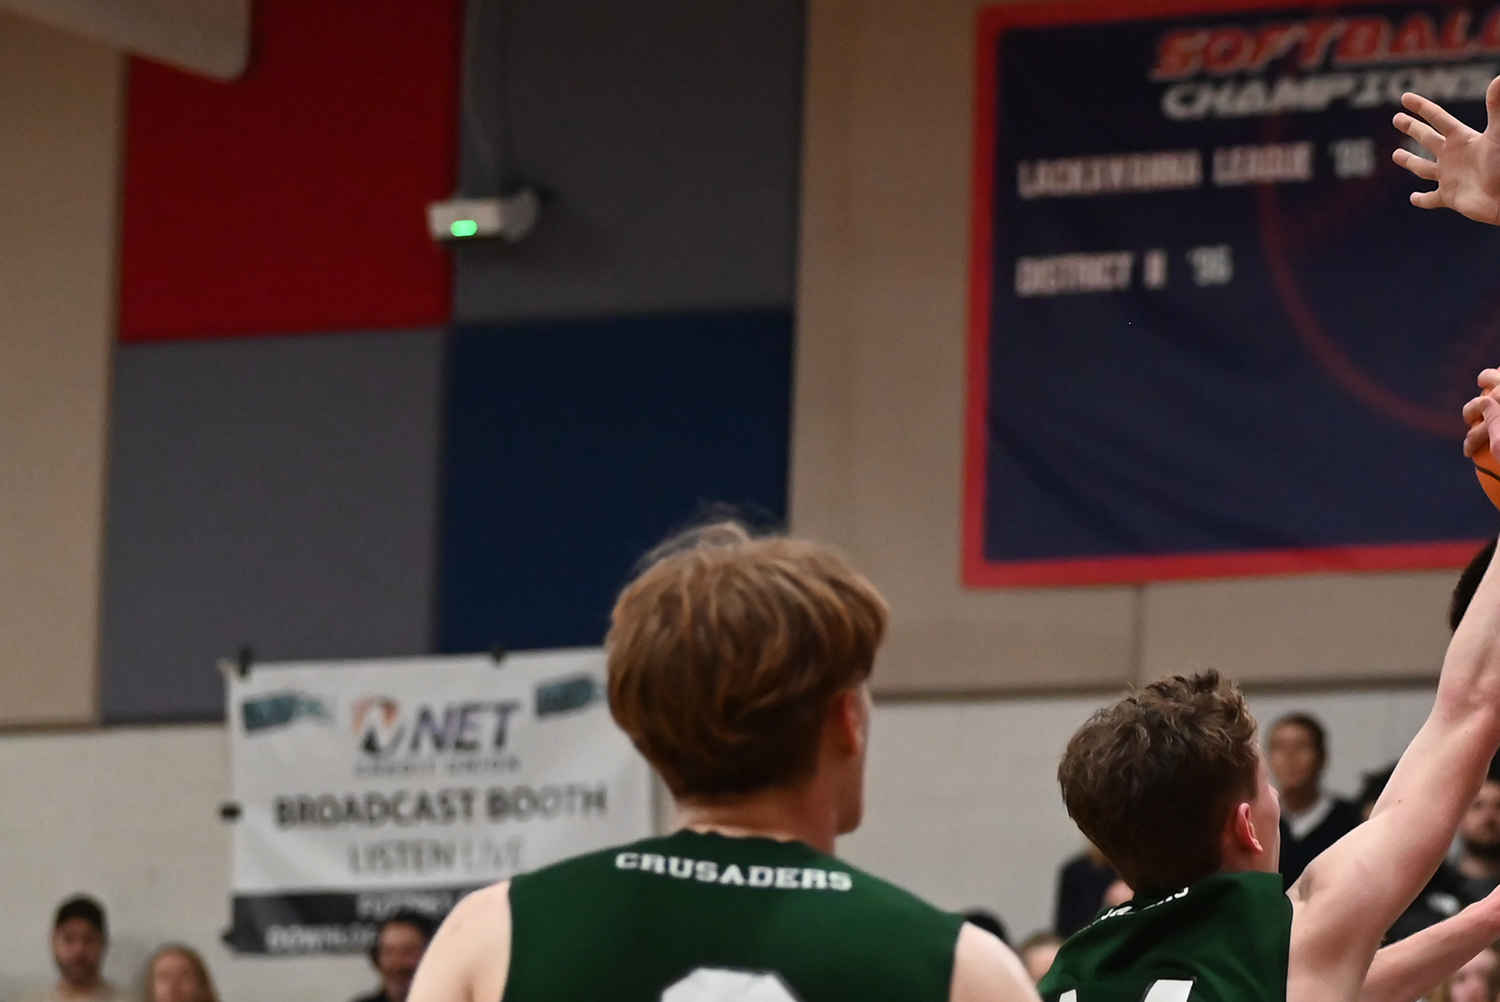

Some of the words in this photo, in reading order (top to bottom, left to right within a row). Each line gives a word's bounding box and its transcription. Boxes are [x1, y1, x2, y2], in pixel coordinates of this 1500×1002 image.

[1161, 63, 1499, 119] CHAMPIONS
[1017, 151, 1202, 197] LACKAWANNA
[1213, 143, 1312, 184] LEAGUE
[1015, 252, 1133, 295] DISTRICT
[410, 700, 523, 750] NET
[275, 787, 474, 829] BROADCAST
[486, 783, 607, 823] BOOTH
[350, 840, 455, 874] LISTEN
[464, 836, 524, 870] LIVE
[615, 852, 853, 892] CRUSADERS
